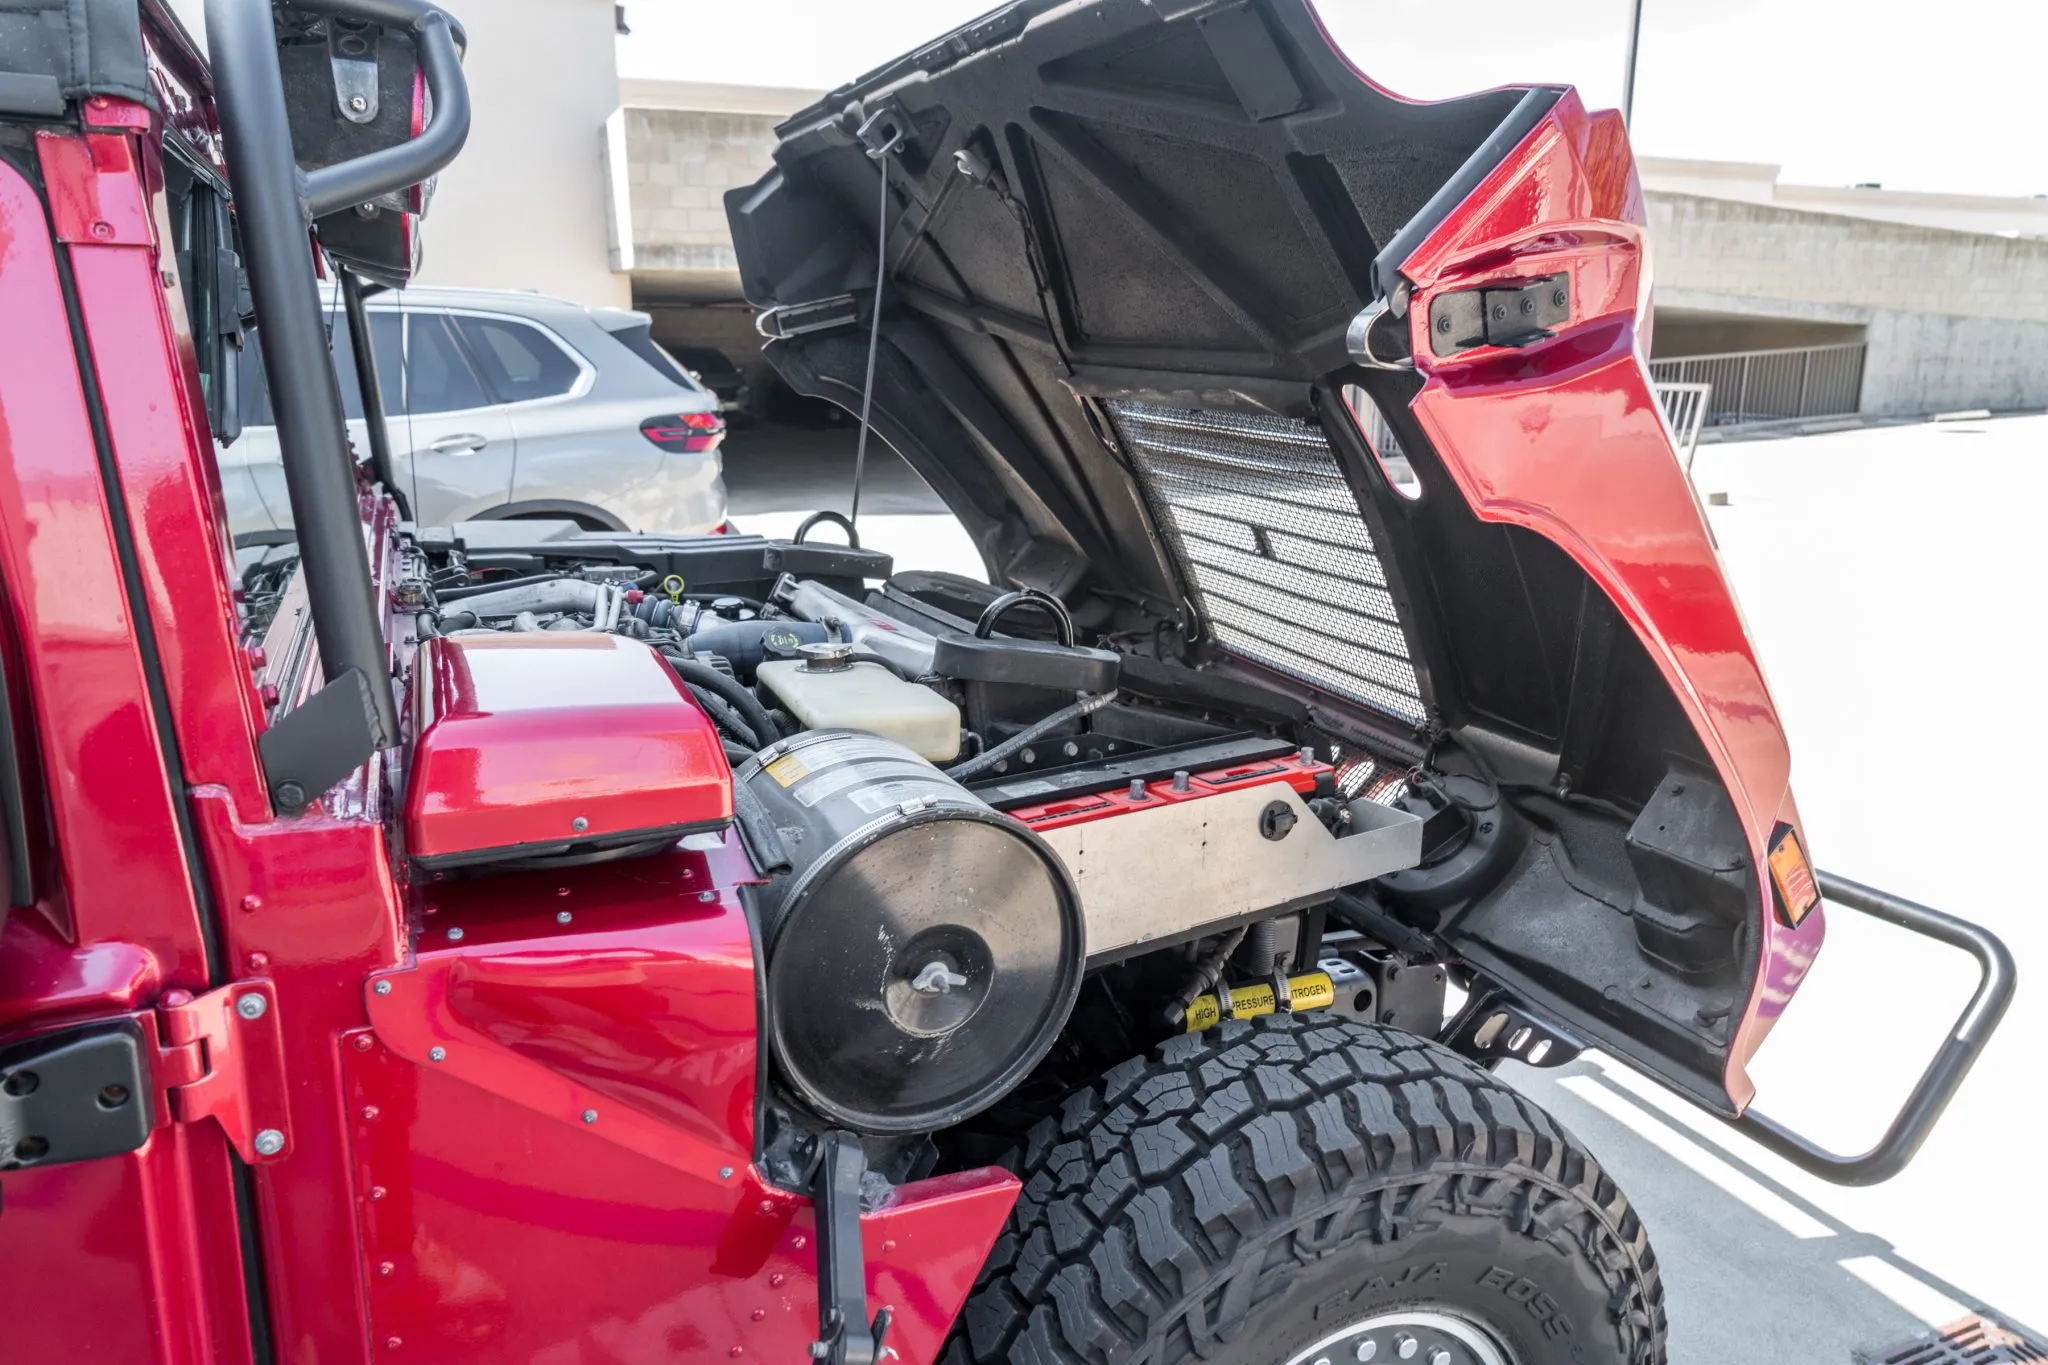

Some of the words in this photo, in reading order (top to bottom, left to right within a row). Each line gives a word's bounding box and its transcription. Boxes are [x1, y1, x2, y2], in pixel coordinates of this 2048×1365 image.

[1195, 1007, 1217, 1020] HIGH
[1291, 984, 1326, 999] ITROGEN
[1313, 1262, 1448, 1321] BAJA
[1474, 1264, 1574, 1341] BOSS
